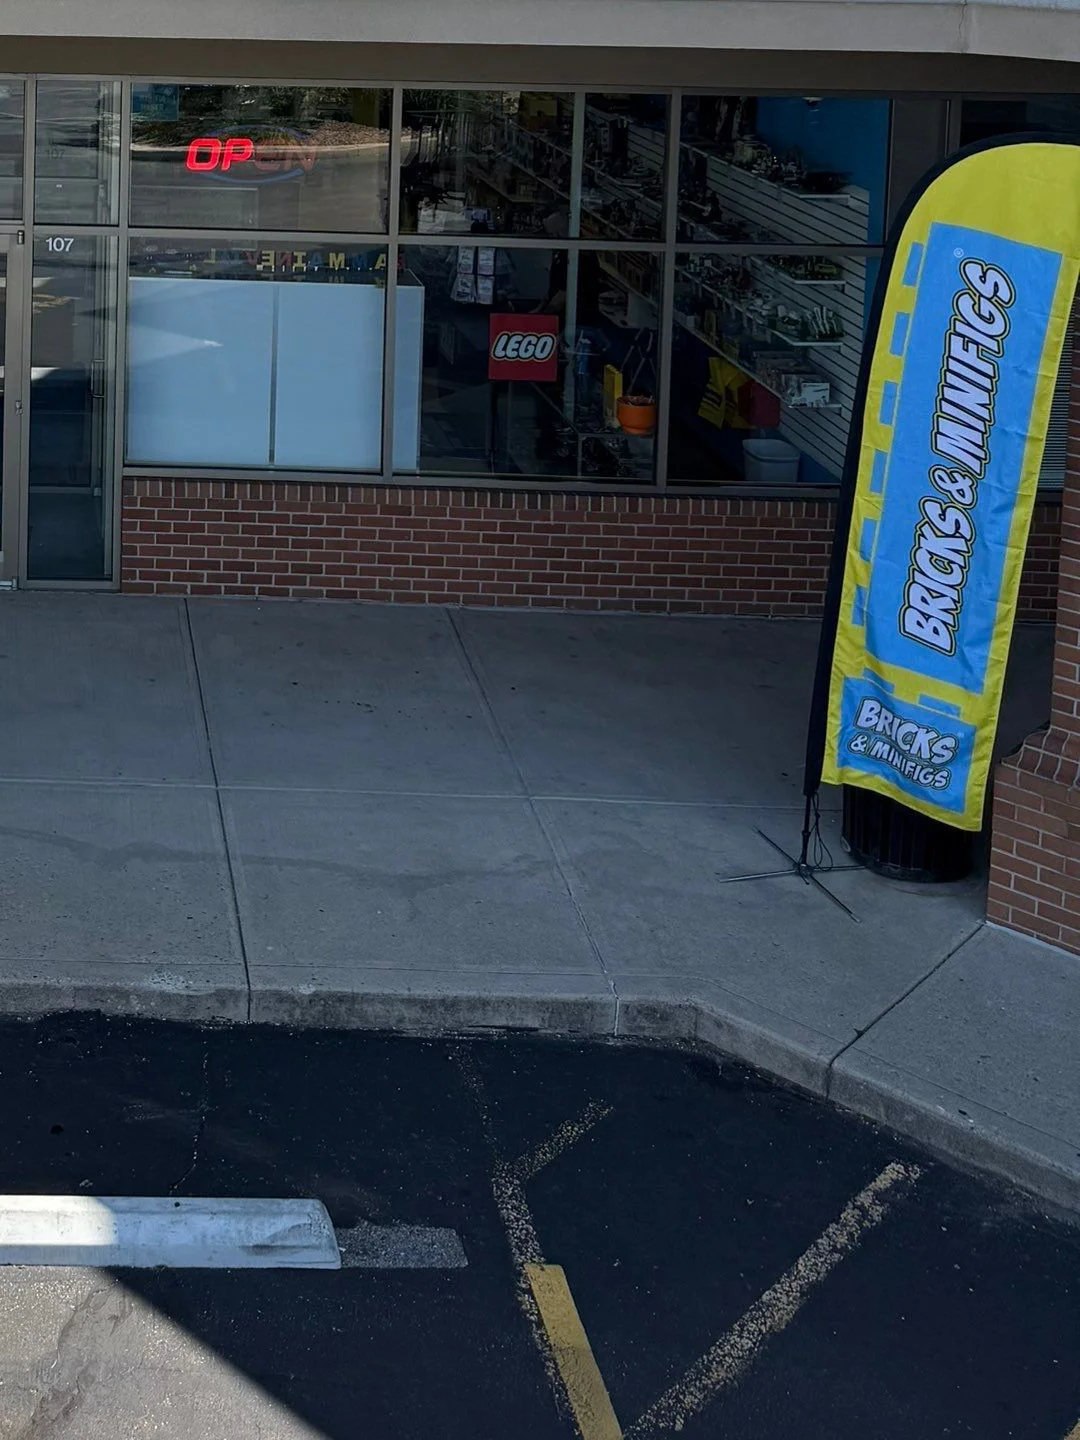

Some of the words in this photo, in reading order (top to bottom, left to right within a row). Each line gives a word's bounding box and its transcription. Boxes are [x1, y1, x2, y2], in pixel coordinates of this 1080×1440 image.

[45, 237, 74, 252] 107
[492, 332, 556, 361] LEGO
[931, 258, 1016, 479] MINIFIGS
[929, 464, 978, 509] &
[899, 496, 976, 657] BRICKS
[854, 697, 959, 766] BRICKS
[847, 733, 869, 754] &
[869, 737, 952, 789] MINIFIGS
